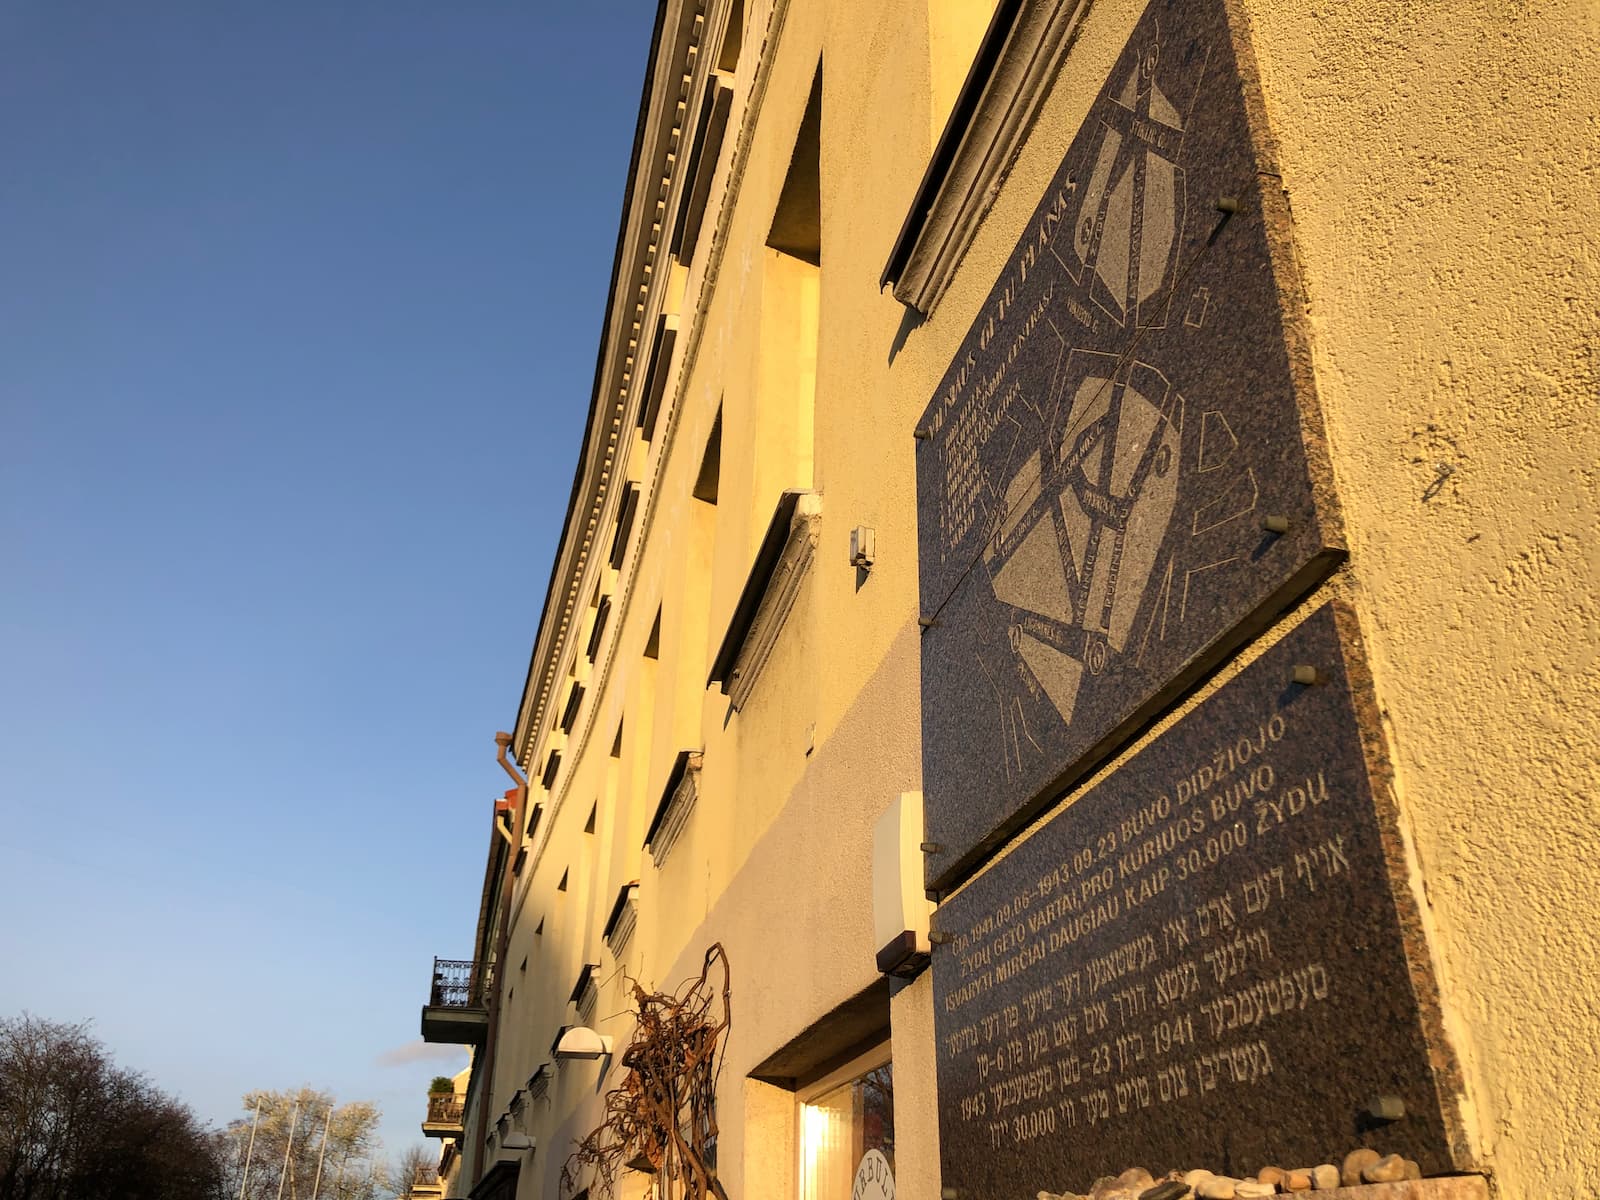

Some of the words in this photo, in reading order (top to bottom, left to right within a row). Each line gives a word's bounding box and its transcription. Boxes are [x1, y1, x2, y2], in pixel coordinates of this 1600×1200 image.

[1121, 795, 1170, 843] BUVO
[1176, 714, 1285, 805] DIDŽIOJO
[994, 923, 1025, 956] GETO
[1118, 808, 1205, 879] KURIUOS
[1210, 765, 1274, 821] BUVO
[996, 939, 1045, 984] MIRČIAI
[1050, 896, 1119, 952] DAUGIAU
[1125, 867, 1169, 909] KAIP
[1176, 820, 1247, 880] 30.000
[1152, 1012, 1194, 1054] 1941
[961, 1091, 986, 1121] 1943
[1012, 1106, 1055, 1143] 30.000
